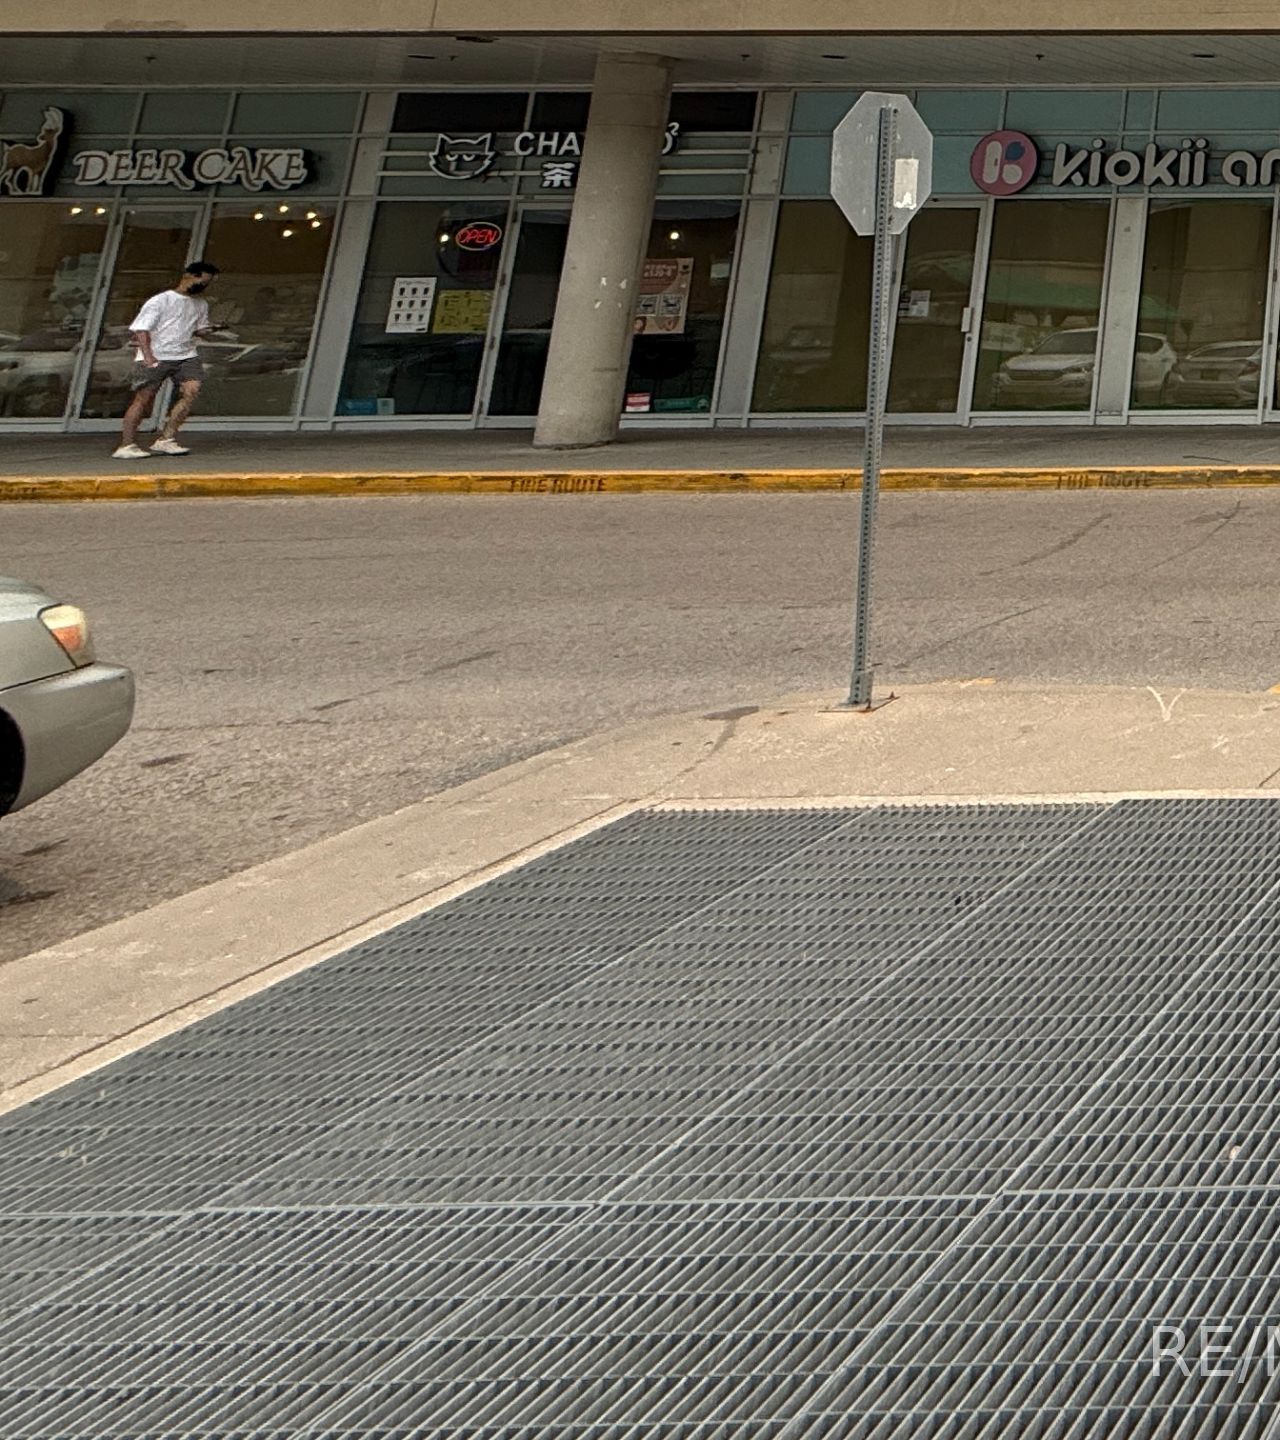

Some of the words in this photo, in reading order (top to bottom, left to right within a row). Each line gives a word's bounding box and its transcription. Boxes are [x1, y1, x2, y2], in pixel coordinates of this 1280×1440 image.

[73, 149, 195, 191] DEER
[194, 147, 308, 192] CAKE
[459, 229, 499, 244] OPEN
